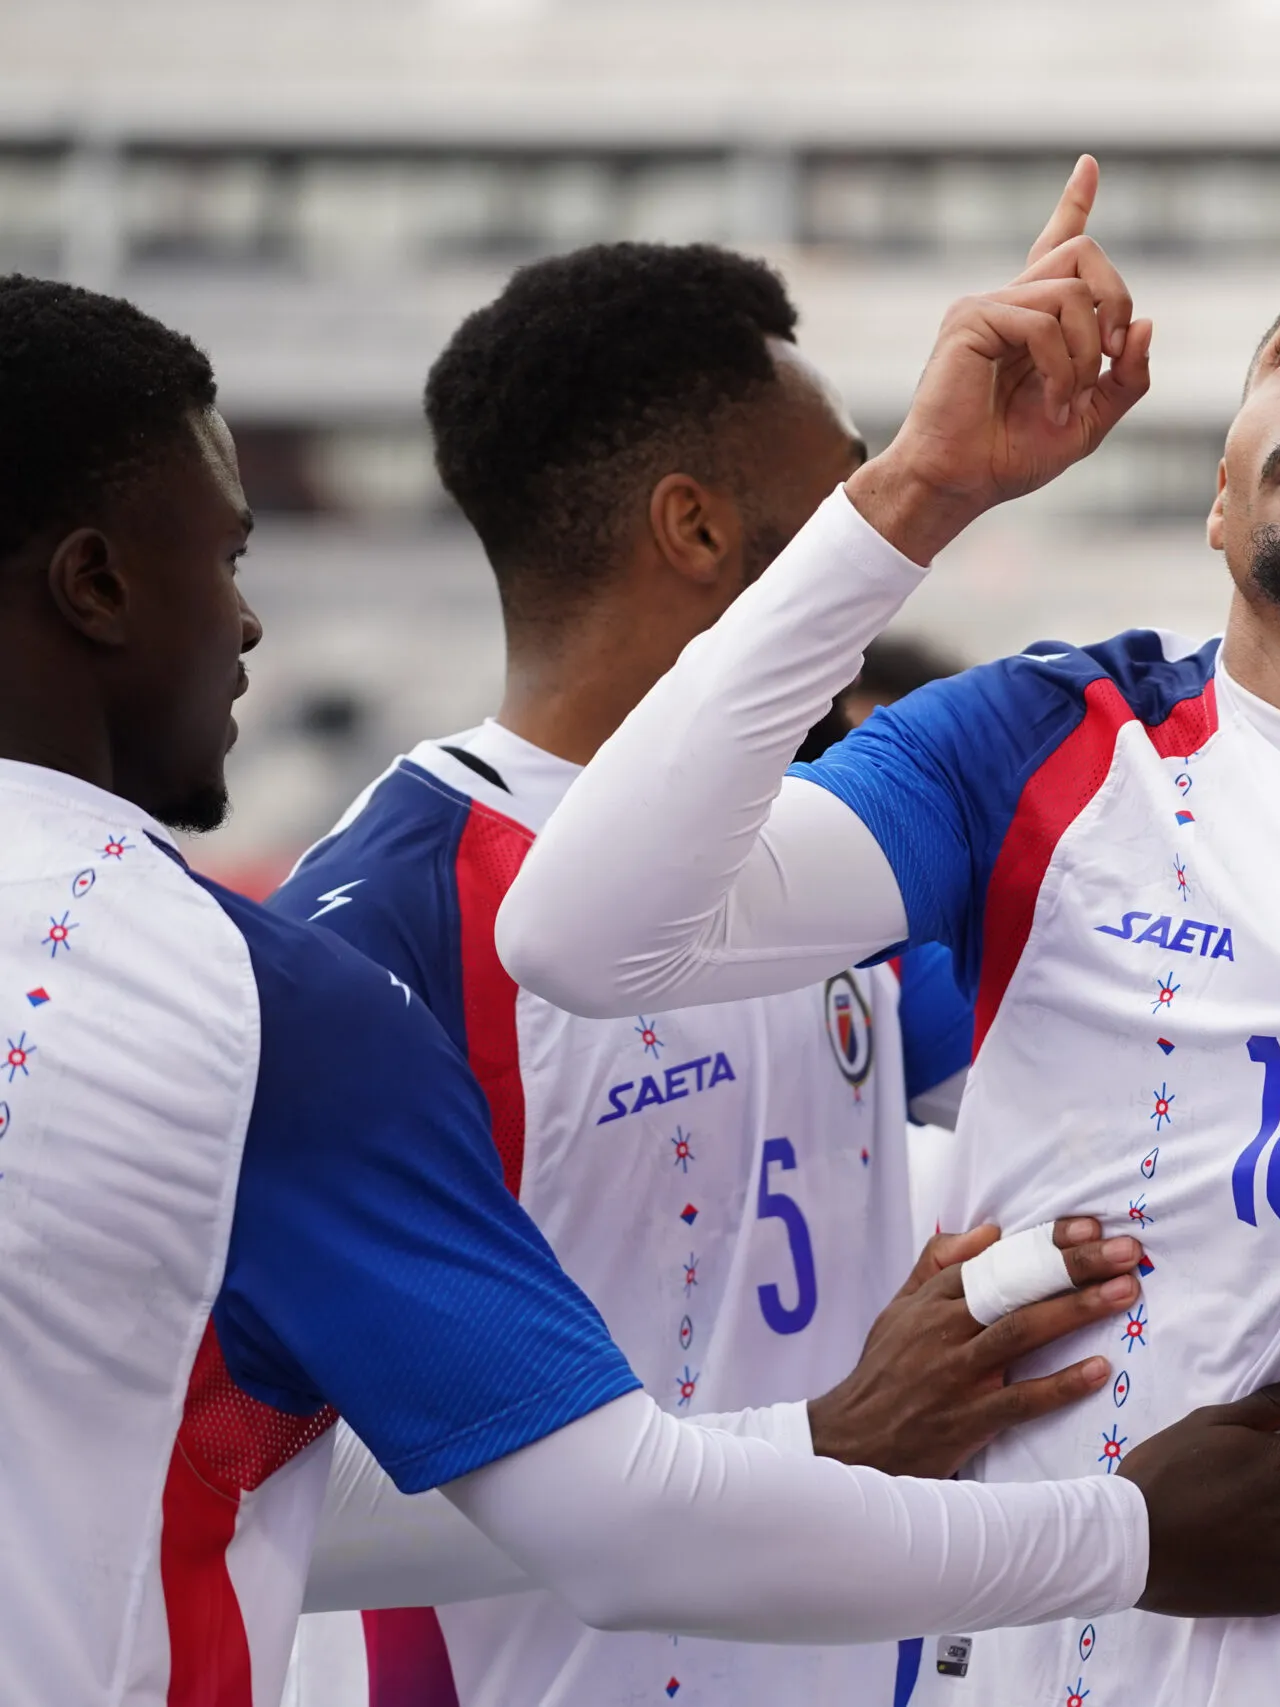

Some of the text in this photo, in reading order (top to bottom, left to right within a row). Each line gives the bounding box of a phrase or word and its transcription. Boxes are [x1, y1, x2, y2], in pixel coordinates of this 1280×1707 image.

[1094, 911, 1235, 962] SAETA
[596, 1052, 737, 1126] SAETA
[757, 1136, 818, 1336] 5
